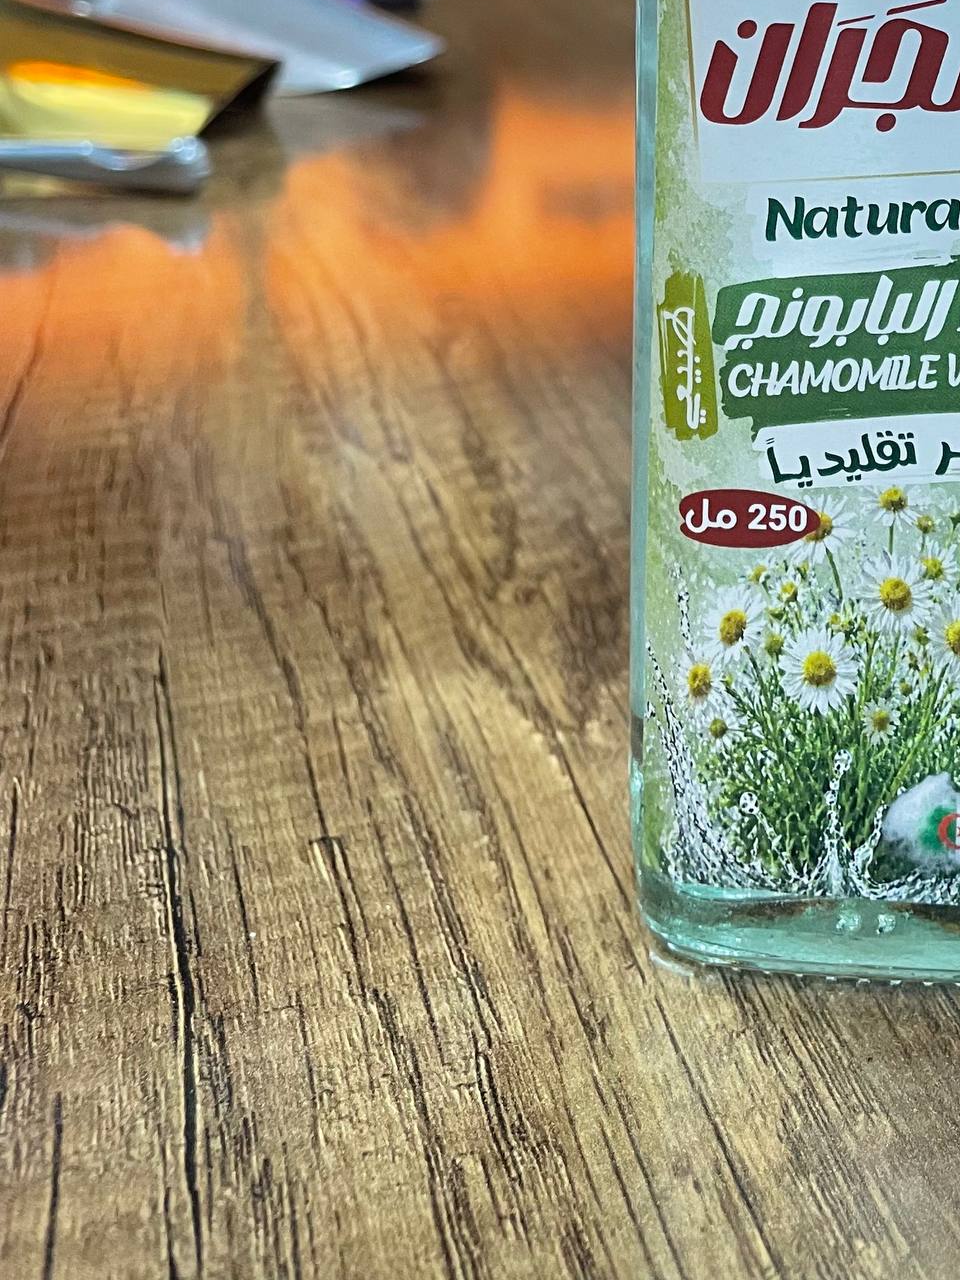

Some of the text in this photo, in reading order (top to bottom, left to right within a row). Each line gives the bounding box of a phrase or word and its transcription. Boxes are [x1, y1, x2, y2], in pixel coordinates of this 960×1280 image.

[723, 274, 960, 351] البابونج
[727, 353, 941, 398] CHAMOMILE
[684, 498, 808, 534] 250 مل
